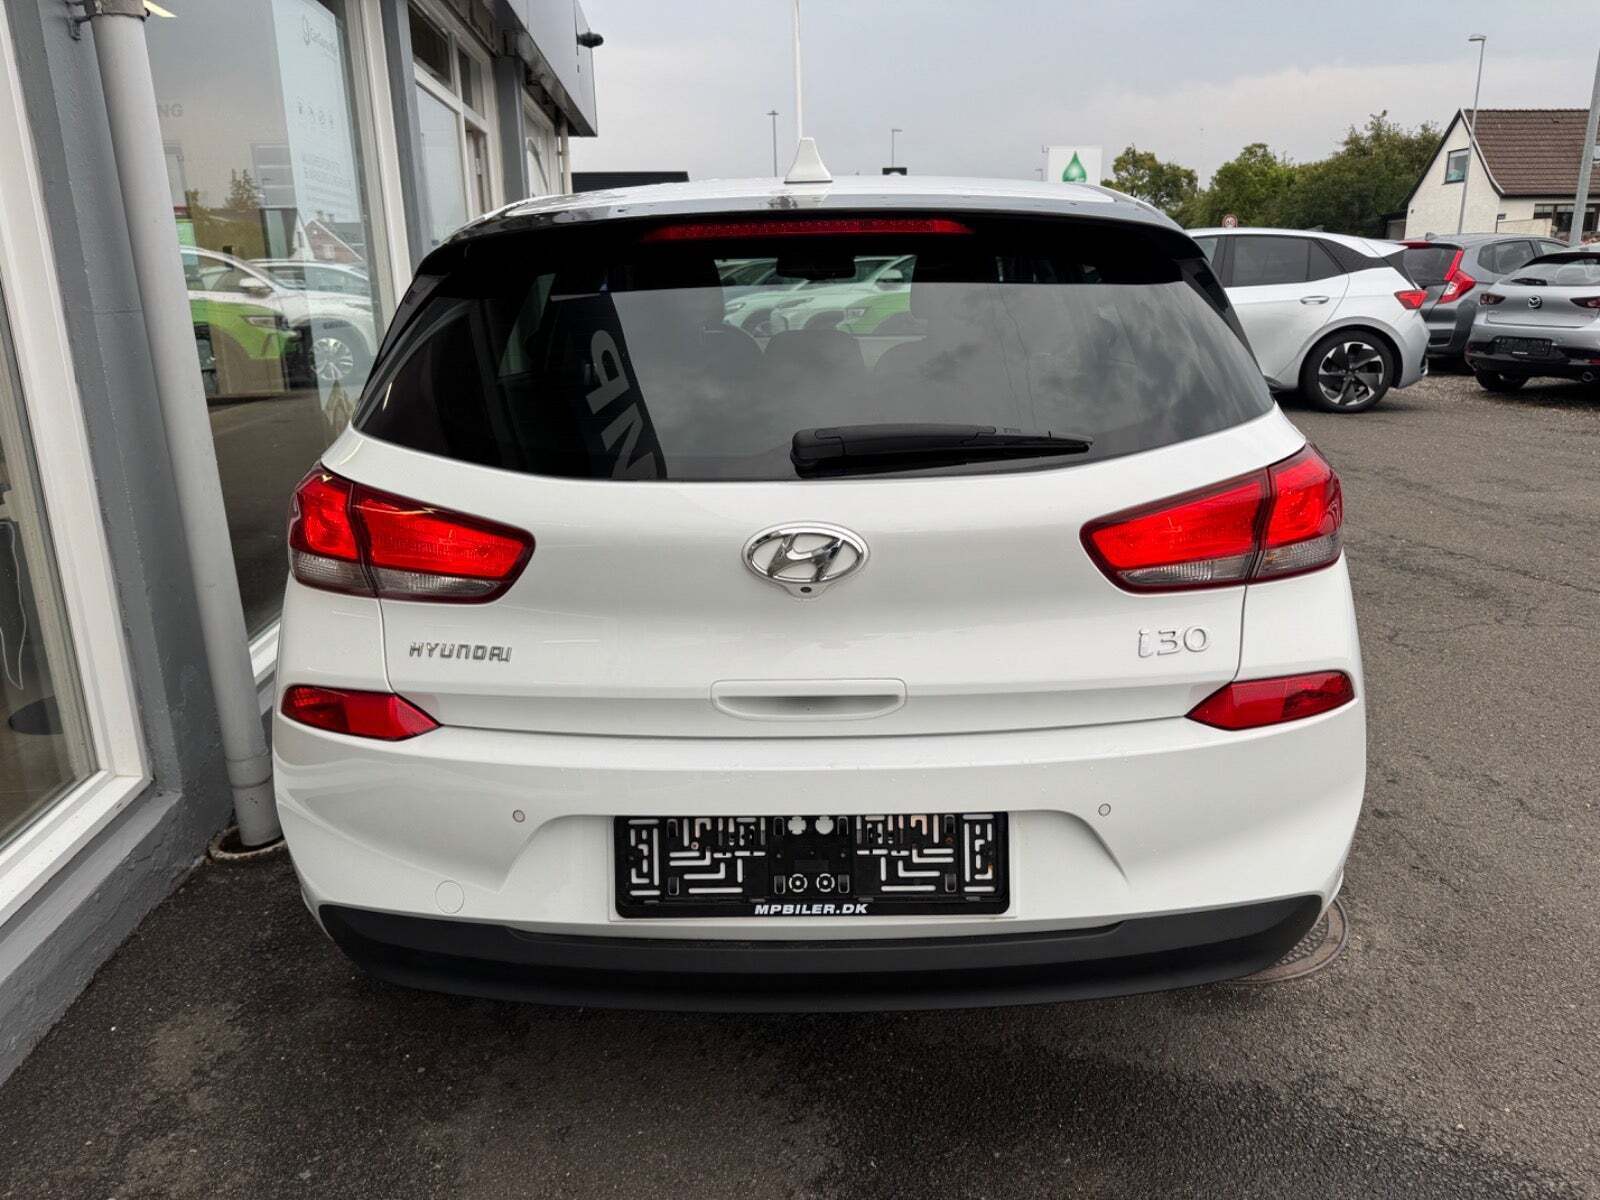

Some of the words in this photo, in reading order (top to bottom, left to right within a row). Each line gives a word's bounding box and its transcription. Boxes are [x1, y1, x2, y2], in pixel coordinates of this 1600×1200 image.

[409, 642, 512, 662] HYUNDAI
[1137, 625, 1209, 659] i30
[754, 902, 867, 916] MPBILER.DK
